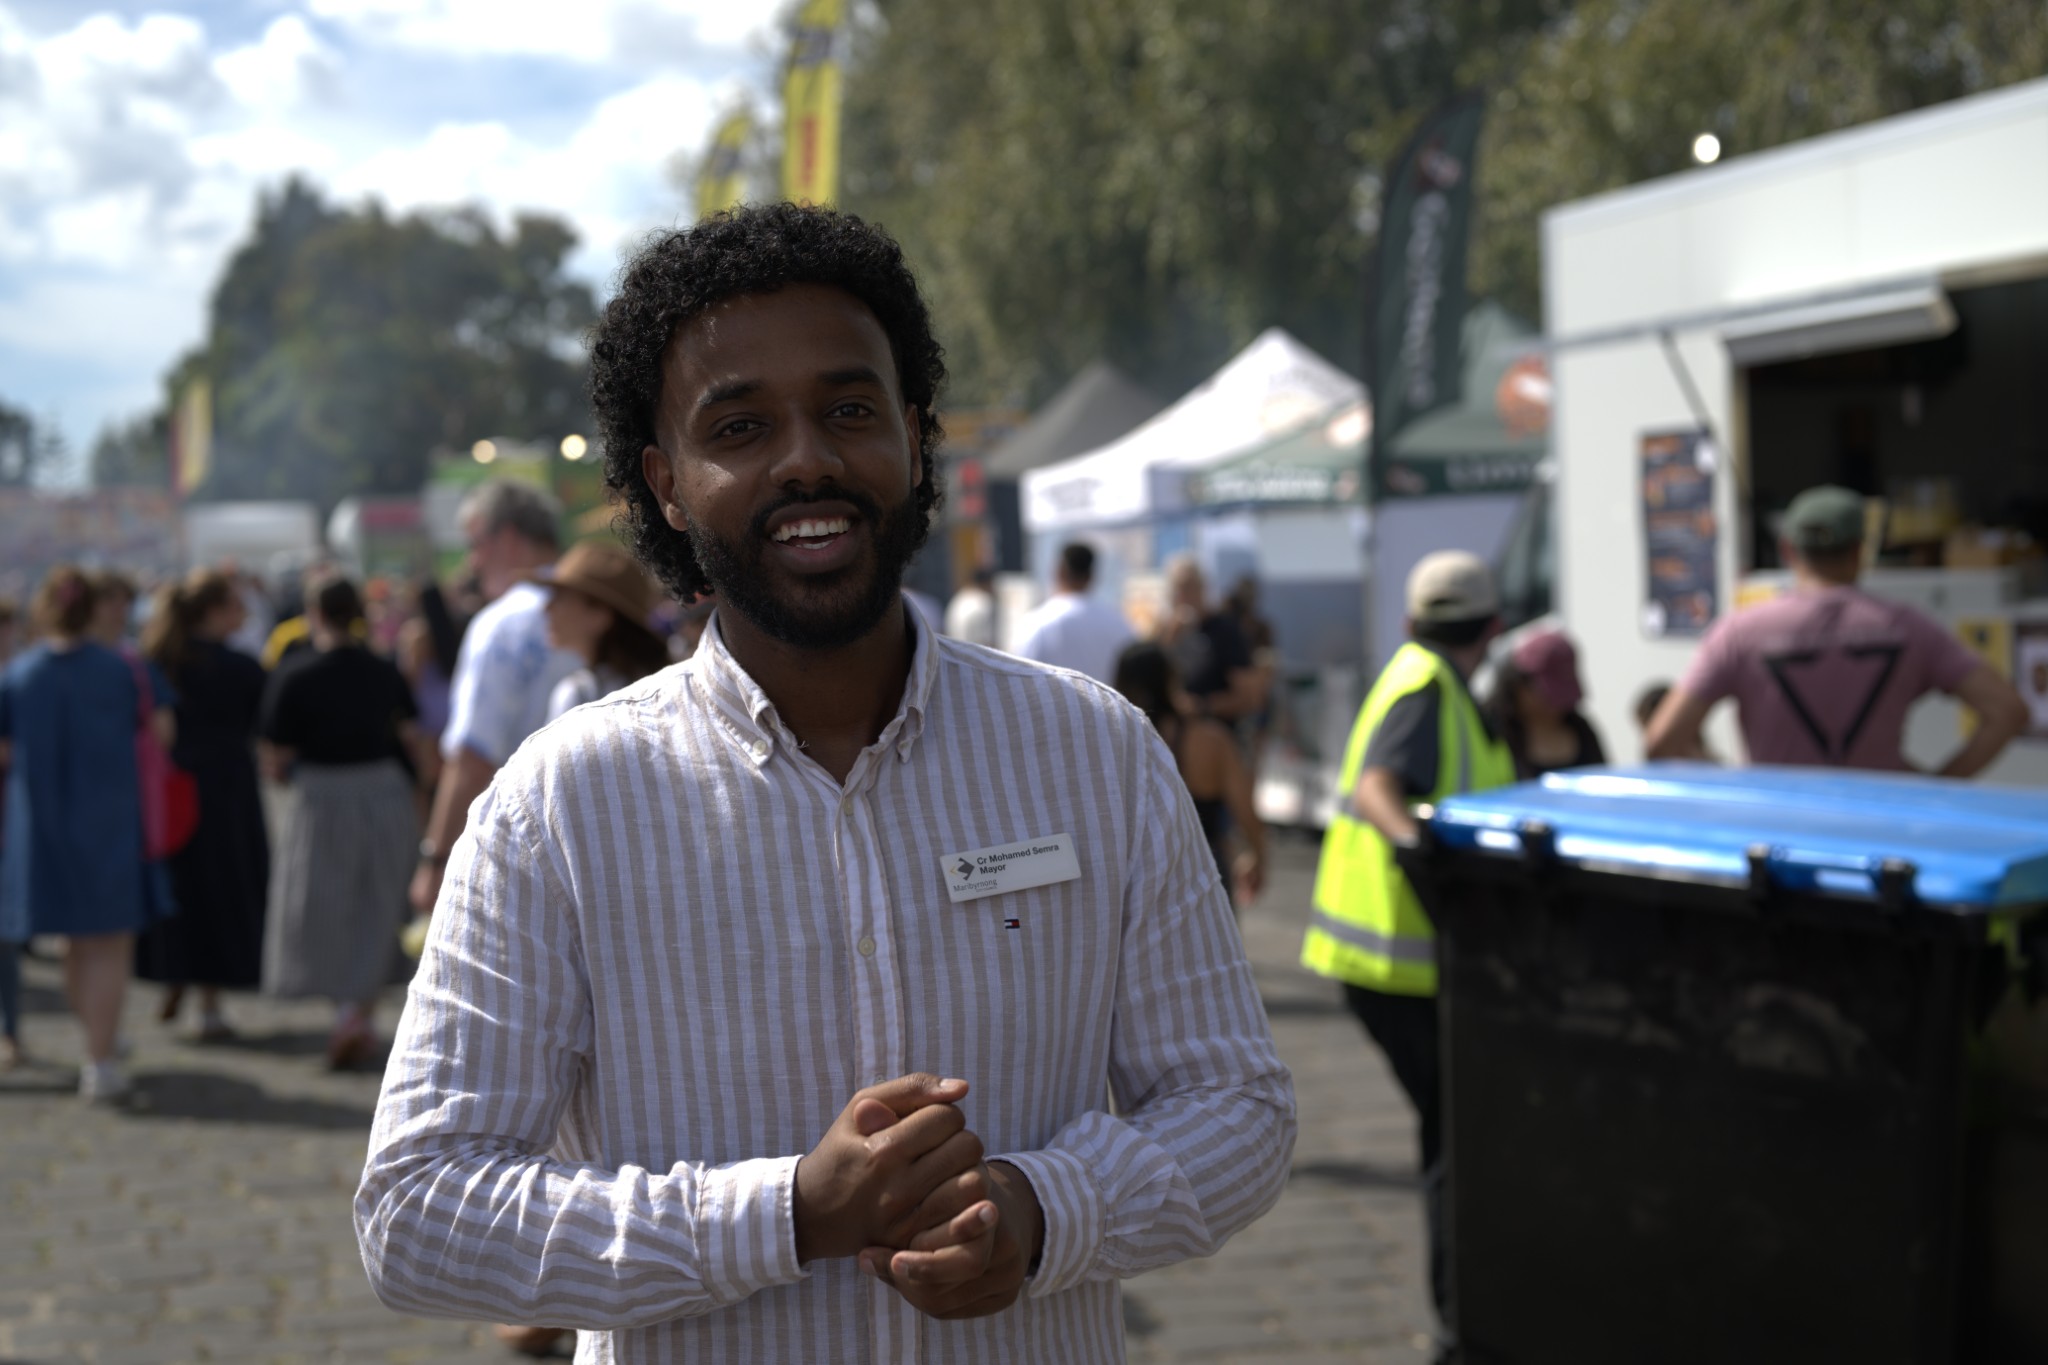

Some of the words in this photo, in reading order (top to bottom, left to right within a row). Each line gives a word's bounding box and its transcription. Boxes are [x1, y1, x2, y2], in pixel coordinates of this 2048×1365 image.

[977, 857, 987, 865] Cr
[989, 850, 1031, 863] Mohamed
[1032, 844, 1059, 855] Semra
[980, 864, 1006, 875] Mayor
